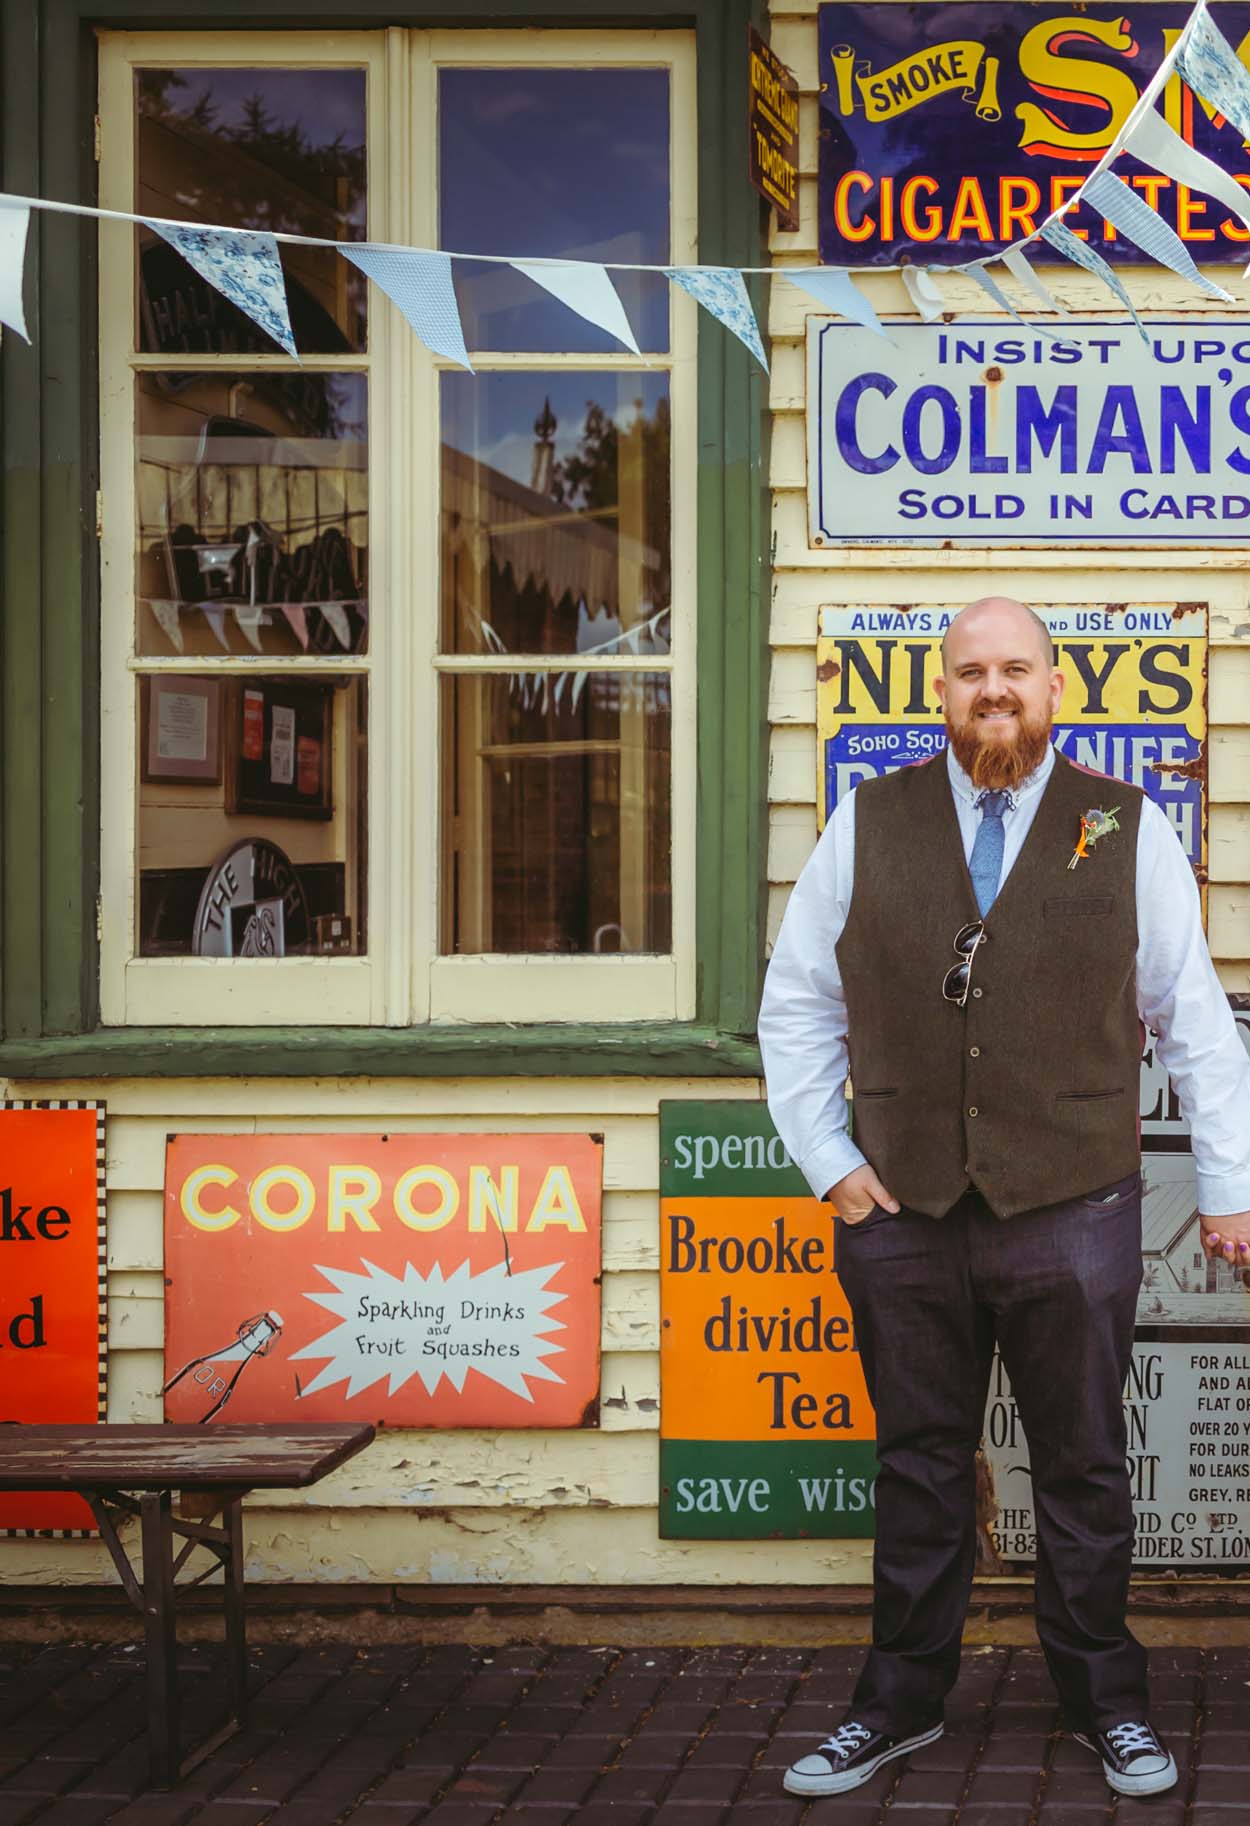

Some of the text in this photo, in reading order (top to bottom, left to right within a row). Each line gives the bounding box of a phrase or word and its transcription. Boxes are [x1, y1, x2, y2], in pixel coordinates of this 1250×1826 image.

[869, 50, 968, 112] SMOKE
[937, 335, 1121, 365] INSIST
[898, 488, 1026, 520] SOLD
[1050, 491, 1093, 519] IN
[851, 612, 1173, 631] ALWAYS A ND USE ONLY
[833, 639, 1193, 715] NIY'S
[847, 729, 947, 758] SOHO SQU
[202, 864, 239, 933] THE
[180, 1165, 587, 1233] CORONA
[668, 1216, 824, 1275] Brooke
[358, 1296, 526, 1325] Sparkling Drinks
[427, 1324, 452, 1336] and
[356, 1335, 521, 1360] Fruit Squashes
[1191, 1356, 1219, 1370] FOR
[1224, 1356, 1250, 1370] ALL
[1198, 1377, 1230, 1391] AND
[757, 1372, 854, 1430] Tea
[1198, 1398, 1231, 1411] FLAT
[1189, 1422, 1220, 1436] OVER
[1224, 1422, 1239, 1436] 20
[1189, 1443, 1216, 1457] FOR
[1189, 1464, 1206, 1477] NO
[676, 1467, 876, 1512] save wis
